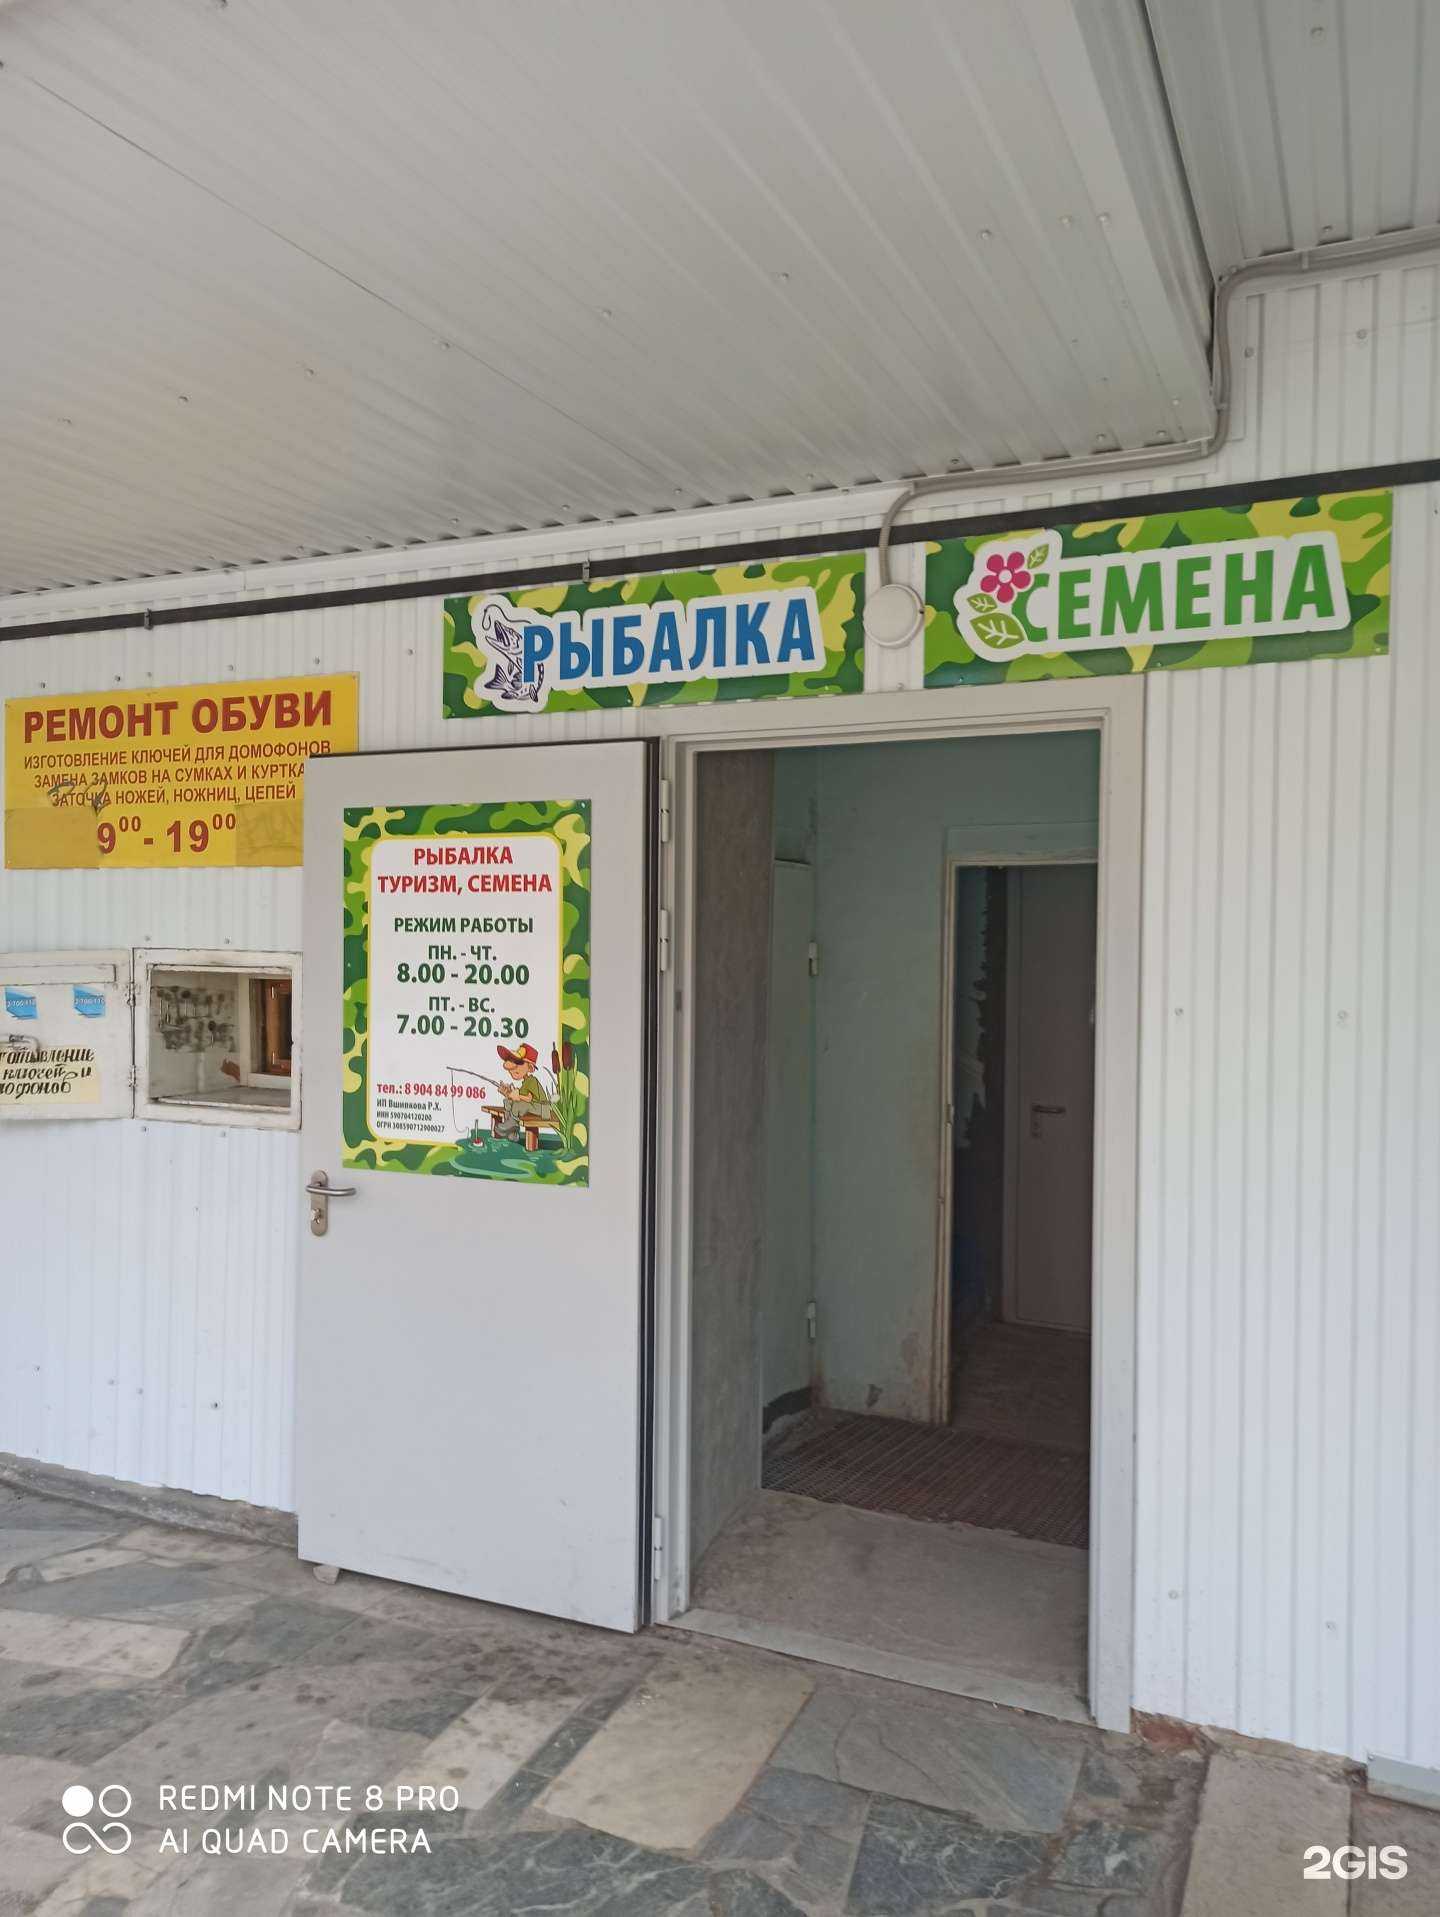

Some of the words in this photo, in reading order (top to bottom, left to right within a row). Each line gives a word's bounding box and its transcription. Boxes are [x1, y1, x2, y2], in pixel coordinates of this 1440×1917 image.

[1011, 543, 1336, 643] СЕМЕНА
[522, 598, 815, 684] РЫБАЛКА
[24, 701, 178, 743] РЕМОНТ
[192, 690, 331, 733] ОБУВИ
[24, 751, 127, 769] ИЗГОТОВЛЕНИЕ
[131, 744, 191, 765] КЛЮЧЕЙ
[194, 746, 225, 764] ДЛЯ
[229, 740, 331, 761] ДОМОФОНОВ
[34, 773, 87, 788] ЗАМЕНА
[91, 769, 147, 786] ЗАМКОВ
[152, 769, 171, 783] НА
[175, 765, 232, 783] СУМКАХ
[237, 765, 247, 780] И
[252, 763, 305, 779] КУРТКА
[52, 791, 111, 807] ЗАТОЧКА
[115, 785, 169, 806] НОЖЕЙ,
[173, 786, 241, 804] НОЖНИЦ,
[246, 780, 296, 803] ЦЕПЕЙ
[413, 846, 513, 866] РЫБАЛКА
[377, 875, 462, 895] ТУРИЗМ,
[467, 874, 552, 893] СЕМЕНА
[394, 917, 456, 933] РЕЖИМ
[460, 917, 534, 934] РАБОТЫ
[428, 945, 457, 961] ПН.
[470, 945, 497, 961] ЧТ.
[396, 962, 446, 984] 8.00
[464, 964, 530, 986] 20.00
[428, 996, 455, 1012] ПТ.
[468, 997, 495, 1013] ВС.
[396, 1014, 445, 1036] 7.00
[463, 1016, 529, 1039] 20.30
[376, 1083, 402, 1095] тел.:
[404, 1082, 411, 1095] 8
[413, 1083, 433, 1097] 904
[435, 1084, 448, 1097] 84
[450, 1085, 464, 1098] 99
[466, 1086, 486, 1099] 086
[376, 1098, 387, 1108] ИП
[376, 1111, 389, 1119] ИНН
[376, 1120, 391, 1130] ОГРН
